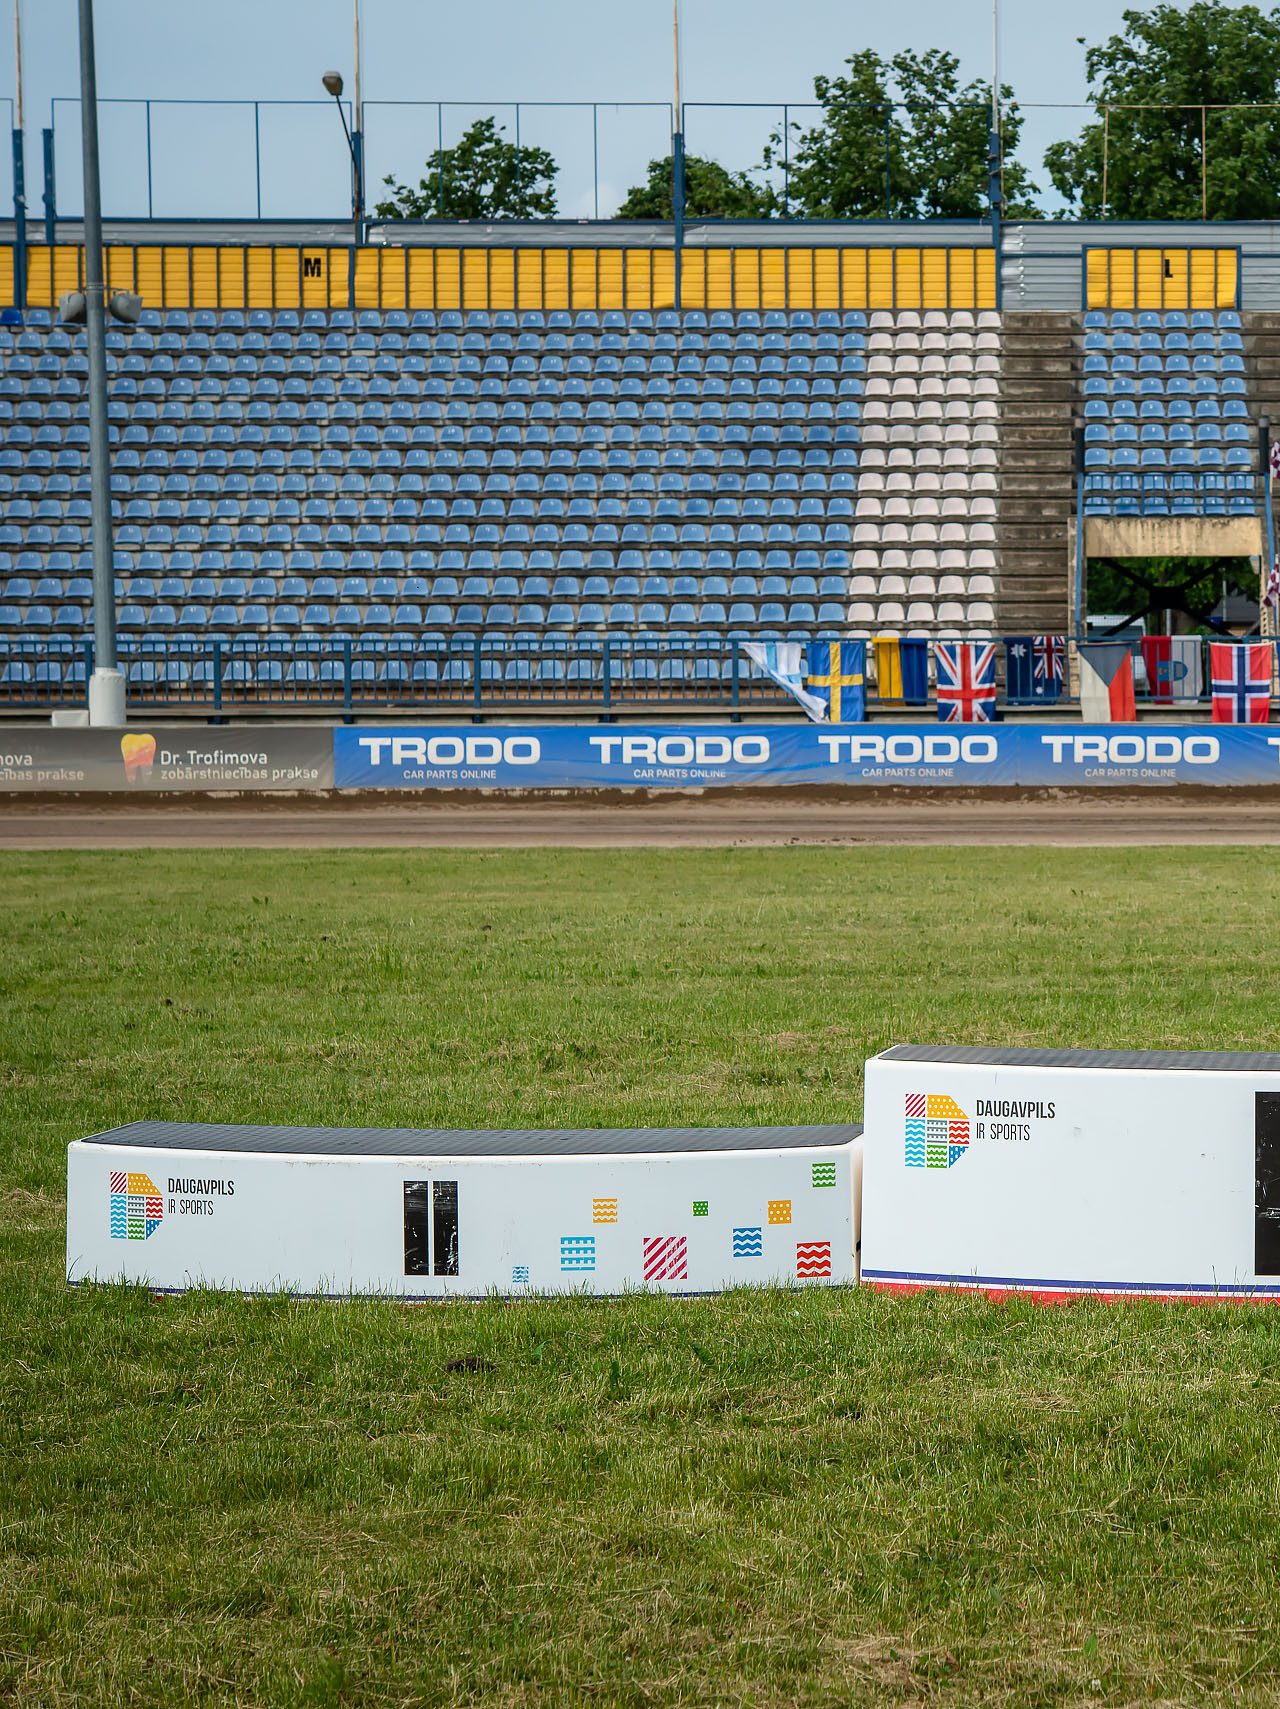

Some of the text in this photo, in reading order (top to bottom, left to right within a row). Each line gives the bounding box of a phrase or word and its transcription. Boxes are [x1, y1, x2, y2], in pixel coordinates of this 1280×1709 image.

[304, 257, 321, 277] M
[1164, 258, 1173, 278] L
[160, 750, 268, 765] Dr. Trofimova
[359, 736, 541, 765] TRODO
[589, 735, 770, 764] TRODO
[818, 735, 998, 764] TRODO
[1041, 735, 1220, 764] TRODO
[37, 768, 85, 782] prakse
[272, 767, 319, 782] prakse
[403, 769, 497, 779] CAR PARTS ONLINE
[633, 768, 726, 778] CAR PARTS ONLINE
[862, 767, 954, 777] CAR PARTS ONLINE
[1084, 768, 1176, 778] CAR PARTS ONLINE
[976, 1099, 1056, 1120] DAUGAVPILS
[976, 1122, 1031, 1141] IR SPORTS
[167, 1177, 235, 1196] DAUGAVPILS
[167, 1198, 214, 1216] IR SPORTS
